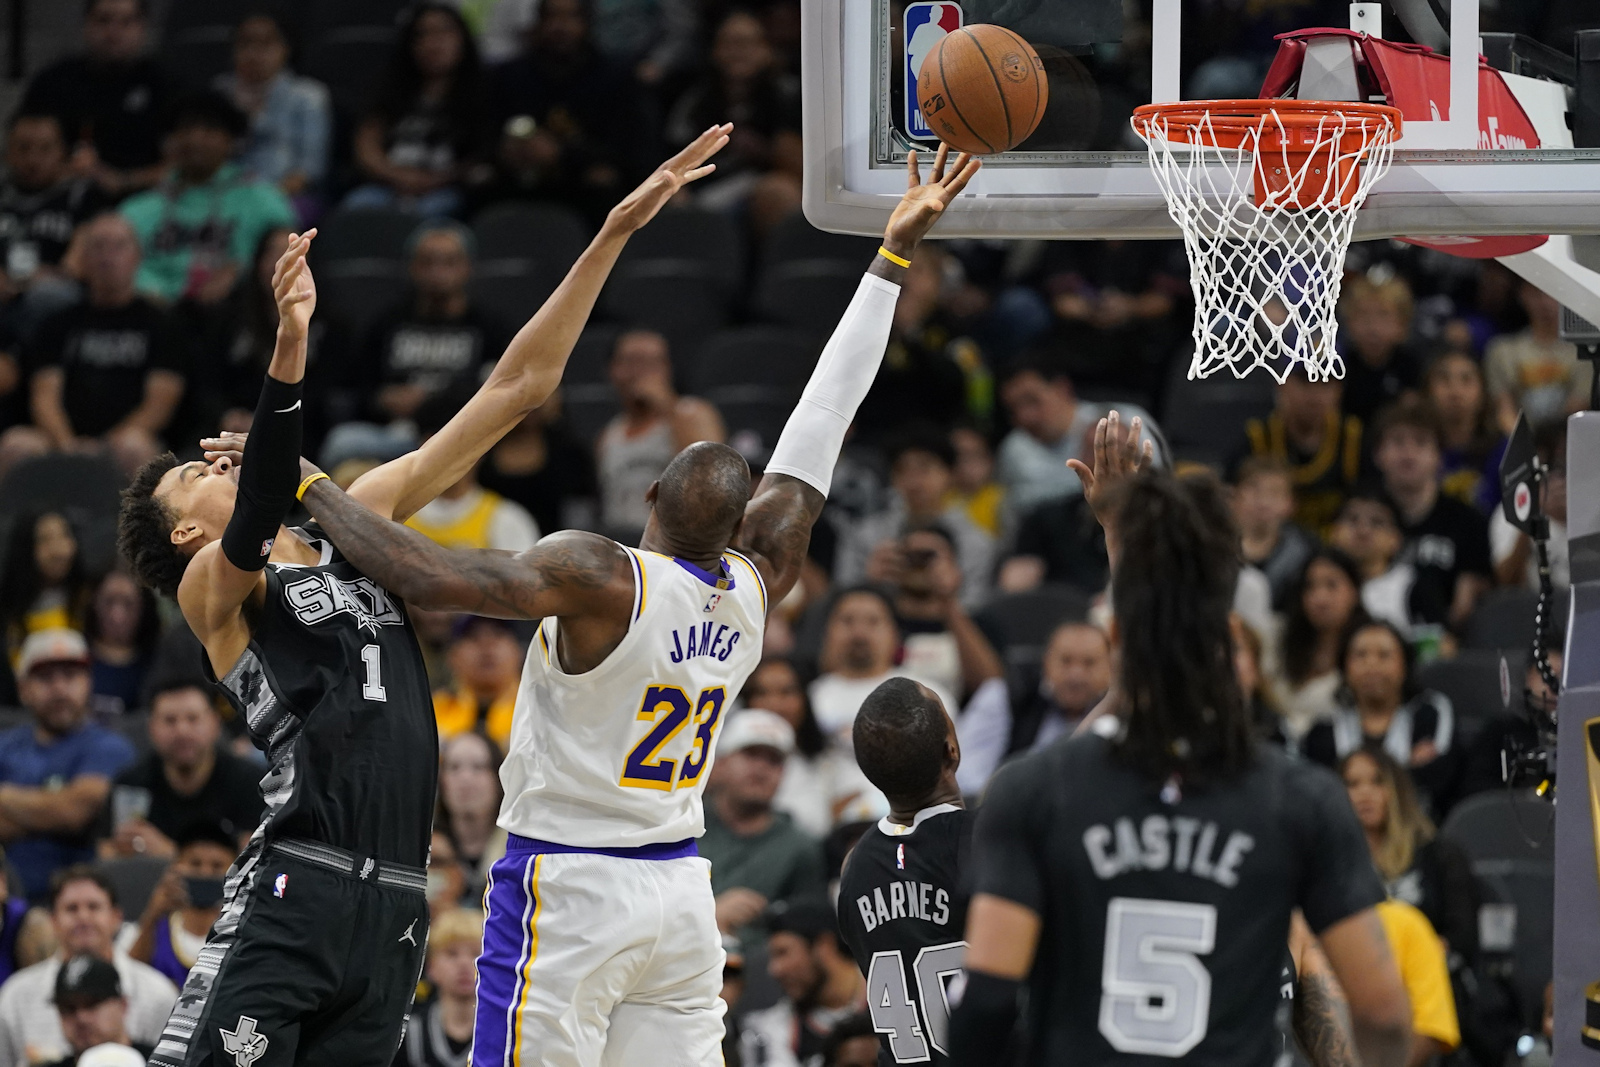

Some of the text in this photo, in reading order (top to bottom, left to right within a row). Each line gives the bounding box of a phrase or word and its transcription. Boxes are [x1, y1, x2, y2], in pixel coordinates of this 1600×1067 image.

[361, 644, 387, 702] 1
[670, 621, 740, 664] JAMES
[619, 683, 727, 792] 23
[1082, 815, 1254, 889] CASTLE
[856, 881, 949, 931] BARNES
[867, 941, 971, 1064] 40
[1098, 897, 1217, 1058] 5
